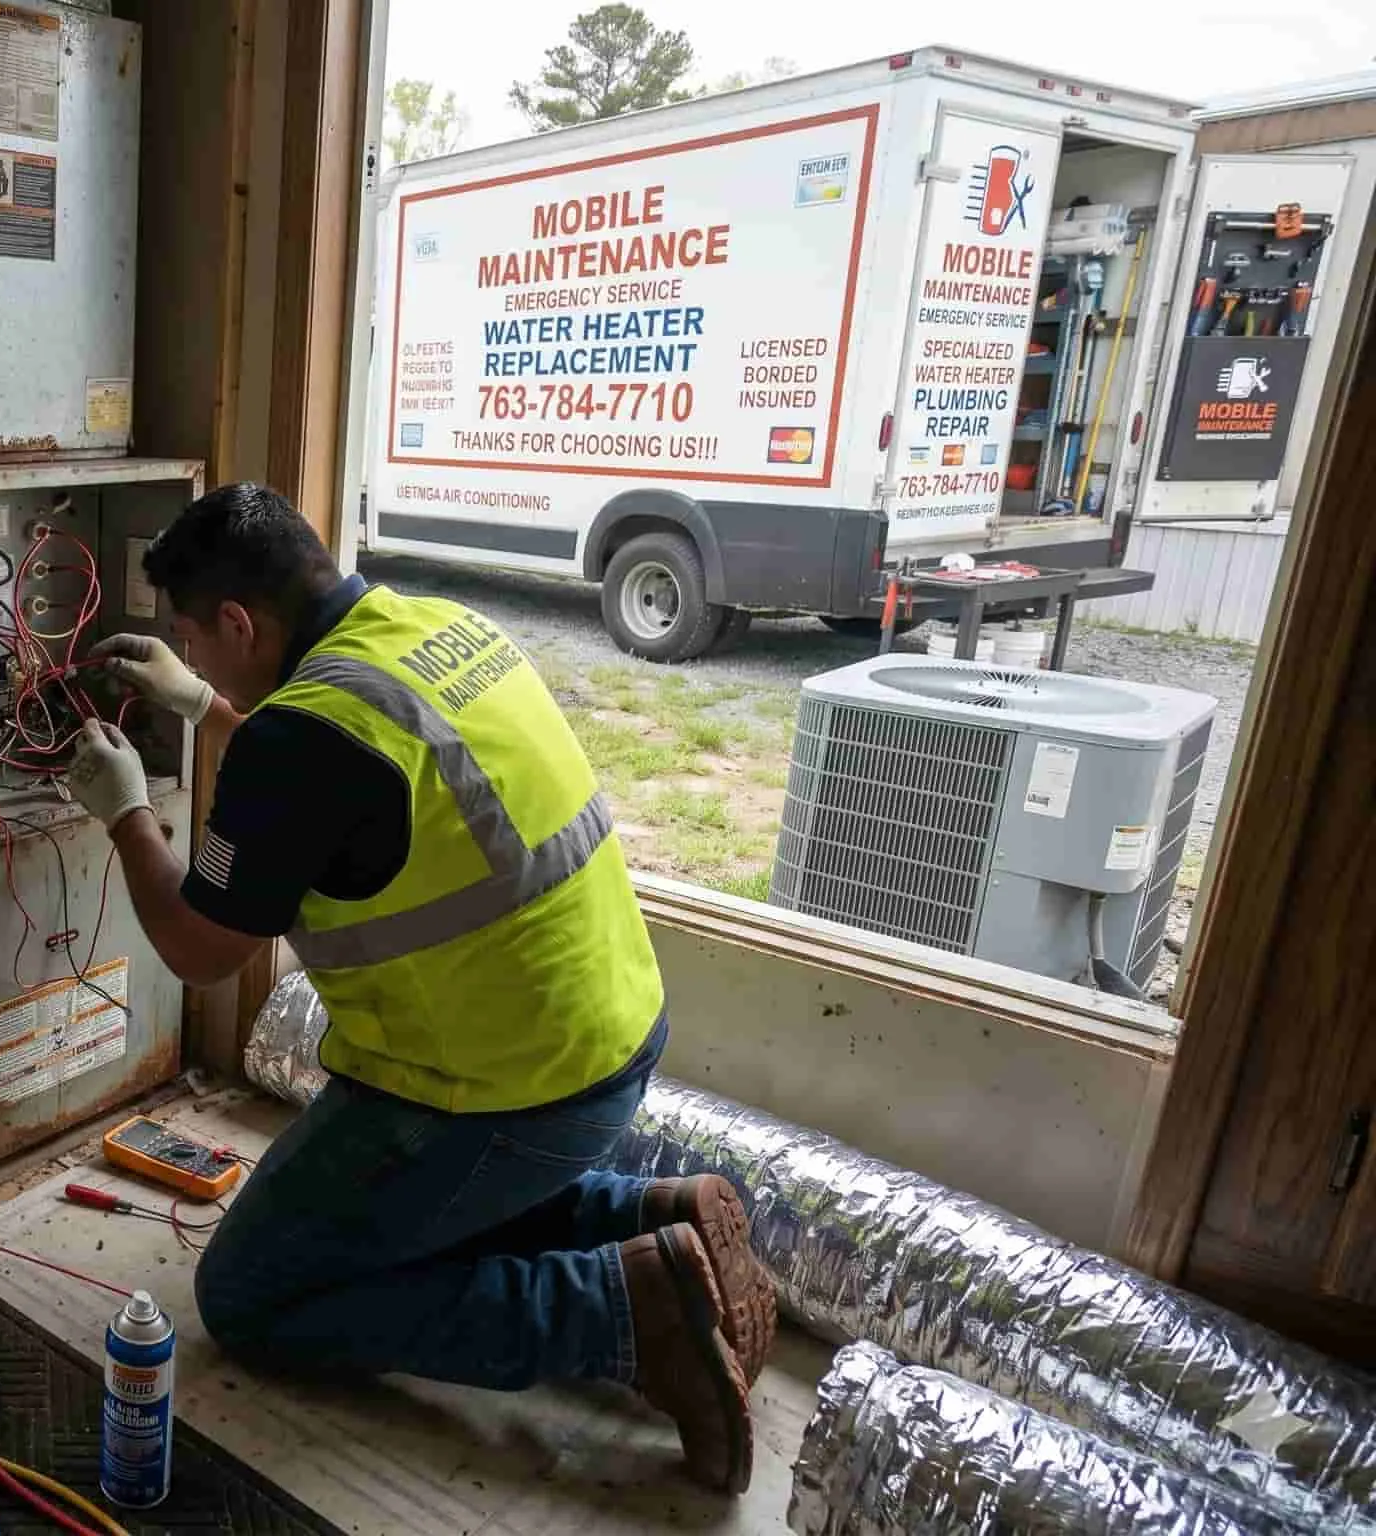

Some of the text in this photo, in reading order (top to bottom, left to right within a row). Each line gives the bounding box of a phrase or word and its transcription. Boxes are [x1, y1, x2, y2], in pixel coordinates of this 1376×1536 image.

[532, 185, 664, 240] MOBILE
[478, 224, 730, 288] MAINTENANCE
[943, 243, 1033, 279] MOBILE
[504, 279, 682, 313] EMERGENCY SERVICE
[923, 279, 1031, 305] MAINTENANCE
[484, 307, 705, 346] WATER HEATER
[919, 307, 1028, 329] EMERGENCY SERVICE
[484, 343, 698, 377] REPLACEMENT
[740, 338, 828, 358] LICENSED
[923, 340, 1014, 360] SPECIALIZED
[744, 365, 817, 383] BORDED
[915, 364, 1015, 385] WATER HEATER
[478, 381, 694, 423] 763-784-7710
[914, 388, 1008, 411] PLUMBING
[1199, 403, 1278, 419] MOBILE
[925, 416, 989, 437] REPAIR
[452, 430, 718, 460] THANKS FOR CHOOSING US!!!
[899, 472, 1000, 498] 763-784-7710
[443, 488, 461, 504] AIR
[463, 490, 551, 511] CONDITIONING
[397, 613, 500, 685] MOBILE
